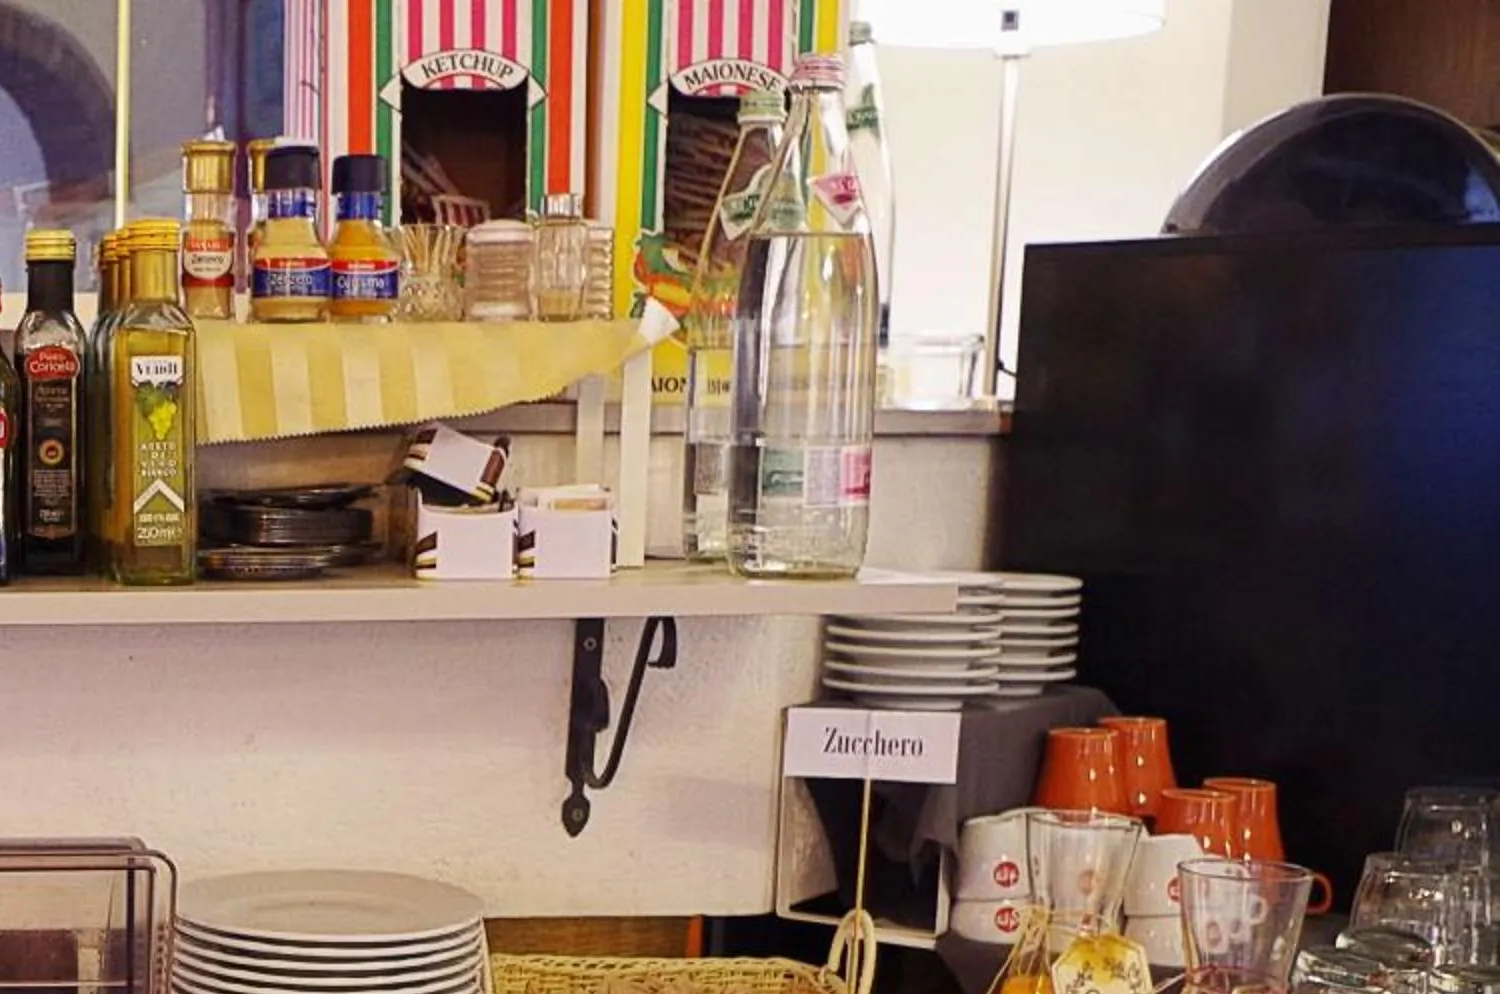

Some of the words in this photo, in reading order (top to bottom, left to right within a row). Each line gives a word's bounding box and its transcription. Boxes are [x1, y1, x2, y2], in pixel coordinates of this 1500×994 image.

[421, 53, 513, 79] KETCHUP
[684, 63, 781, 91] MAIONESE
[822, 726, 924, 757] Zucchero
